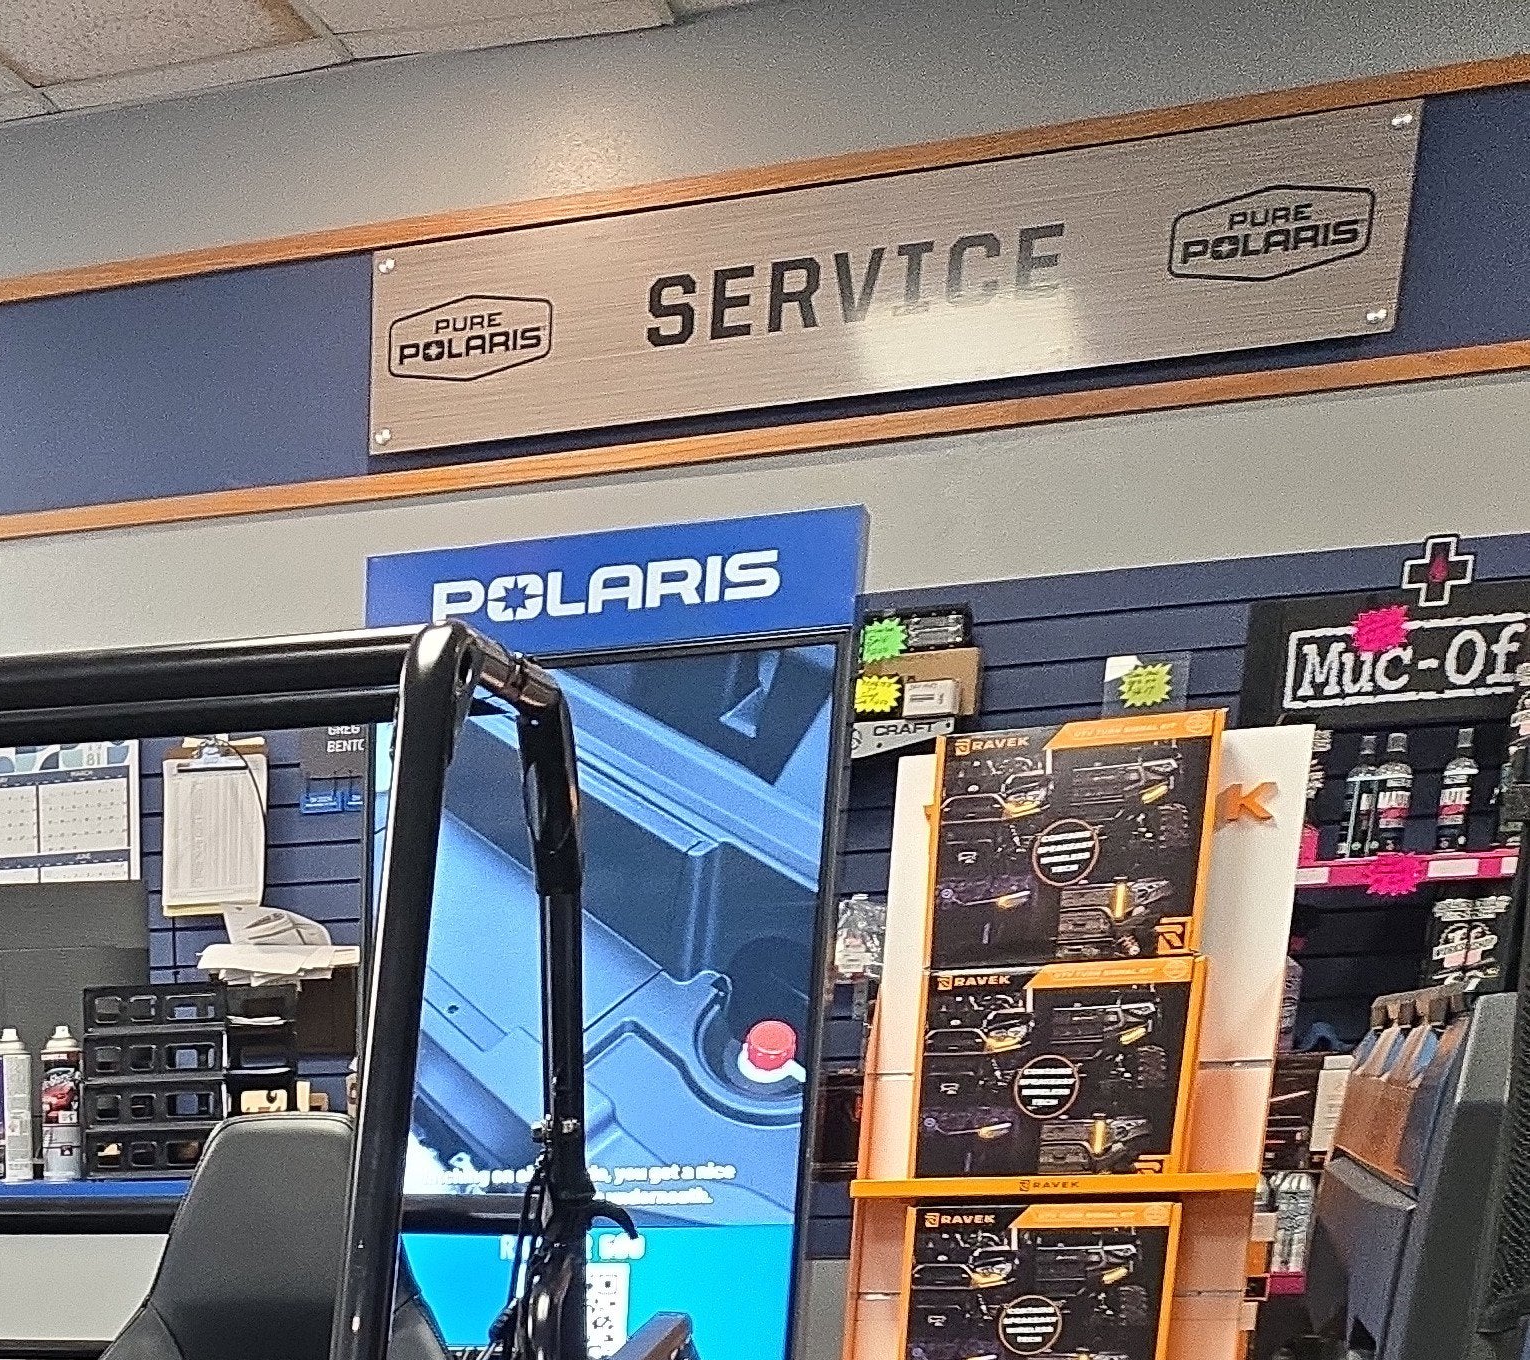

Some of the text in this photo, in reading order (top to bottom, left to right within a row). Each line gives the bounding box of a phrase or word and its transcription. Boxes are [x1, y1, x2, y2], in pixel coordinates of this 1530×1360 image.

[1228, 203, 1312, 232] PURE
[1181, 220, 1361, 264] POLARIS
[647, 222, 1064, 348] SERVICE
[435, 311, 502, 334] PURE
[398, 328, 543, 365] POLARIS
[433, 549, 781, 623] POLARIS
[873, 723, 933, 738] CRAFT
[972, 736, 1030, 751] RAVEK
[954, 976, 1011, 987] RAVEK
[940, 1213, 996, 1225] RAVEK
